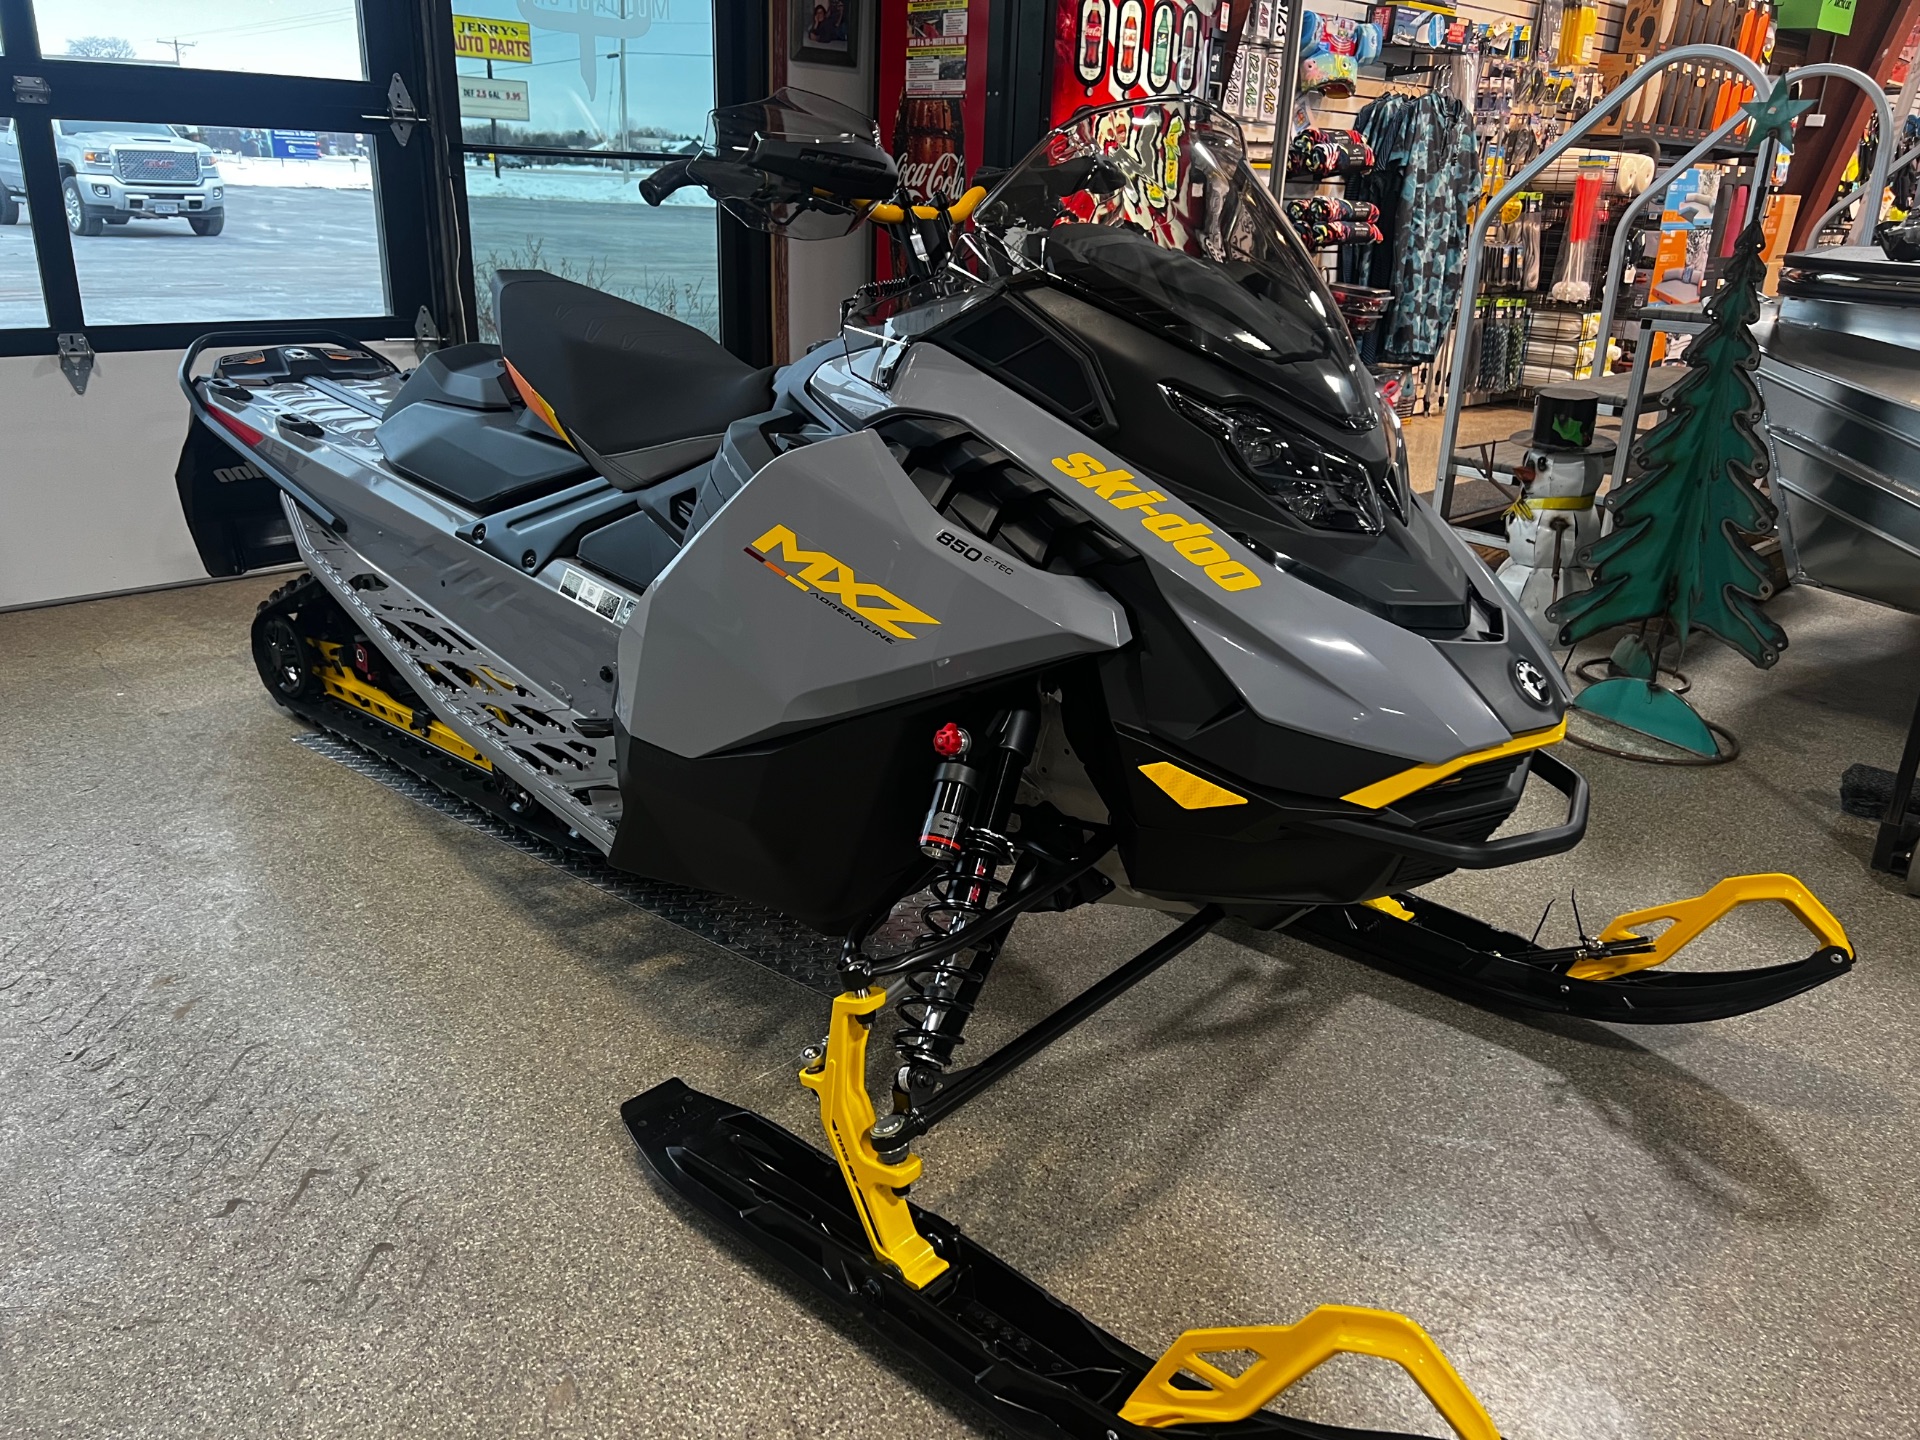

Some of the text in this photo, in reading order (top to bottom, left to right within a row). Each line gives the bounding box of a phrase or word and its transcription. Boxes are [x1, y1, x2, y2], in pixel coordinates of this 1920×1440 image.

[459, 21, 518, 37] JERRYS
[489, 37, 530, 58] PARTS
[488, 90, 501, 100] GAL
[1051, 452, 1262, 592] ski-doo
[936, 531, 1014, 576] 850 E-TEC
[751, 523, 942, 640] MXZ
[809, 591, 897, 645] ADRENALINE
